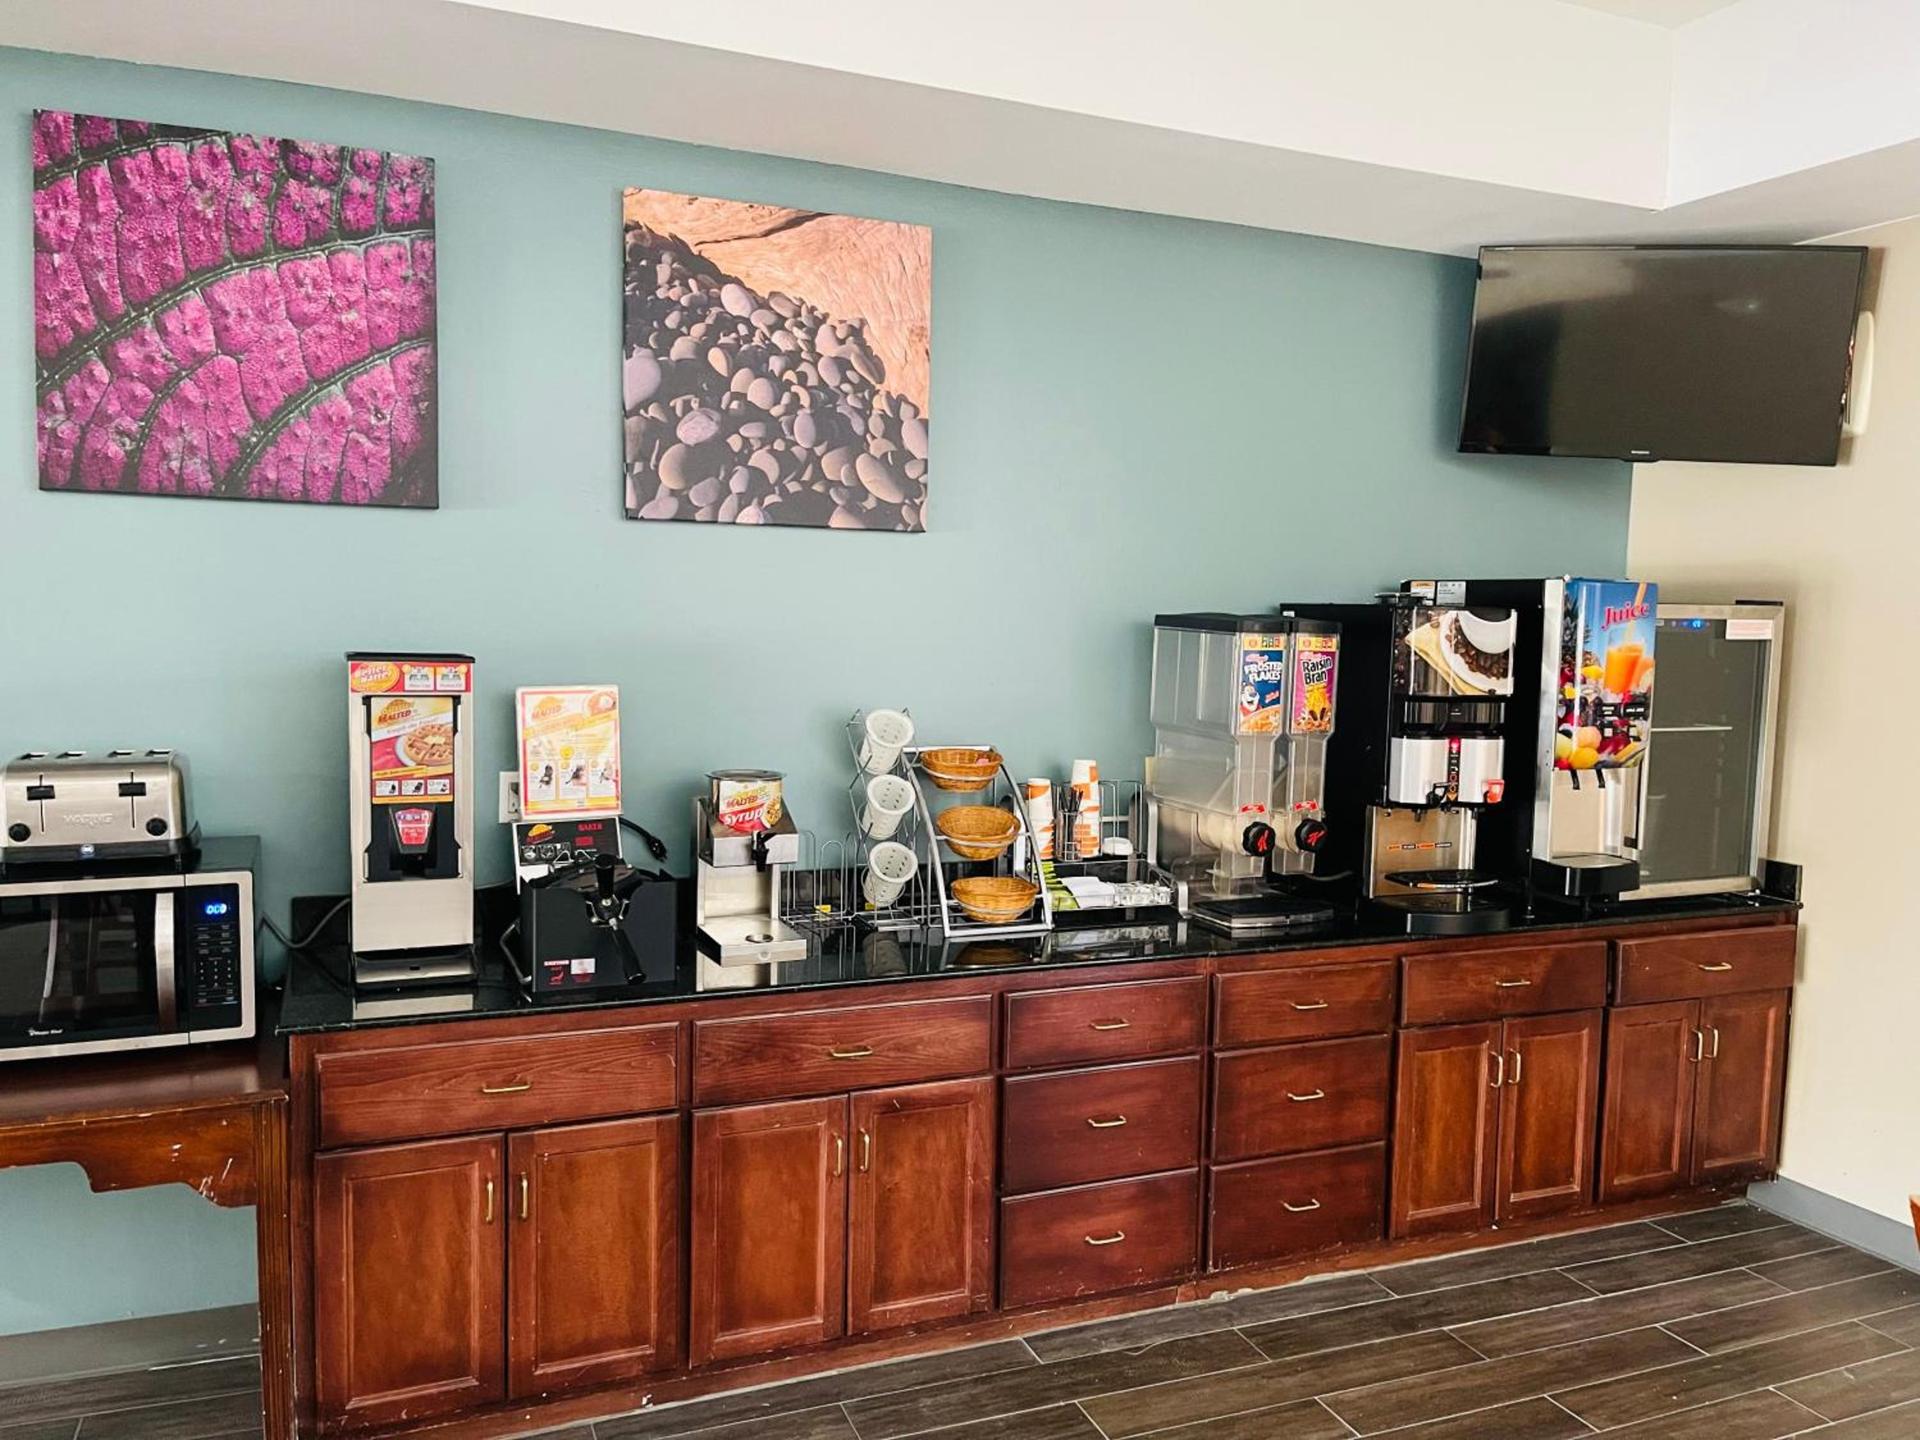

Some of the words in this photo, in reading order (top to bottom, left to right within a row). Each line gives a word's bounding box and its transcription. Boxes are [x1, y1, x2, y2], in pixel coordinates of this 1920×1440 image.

[1600, 602, 1650, 631] Juice
[1244, 661, 1282, 675] FROSTED
[1302, 657, 1332, 673] Raisin
[1249, 671, 1280, 685] FLAKES
[1304, 671, 1327, 686] Bran
[724, 808, 764, 827] Syrup
